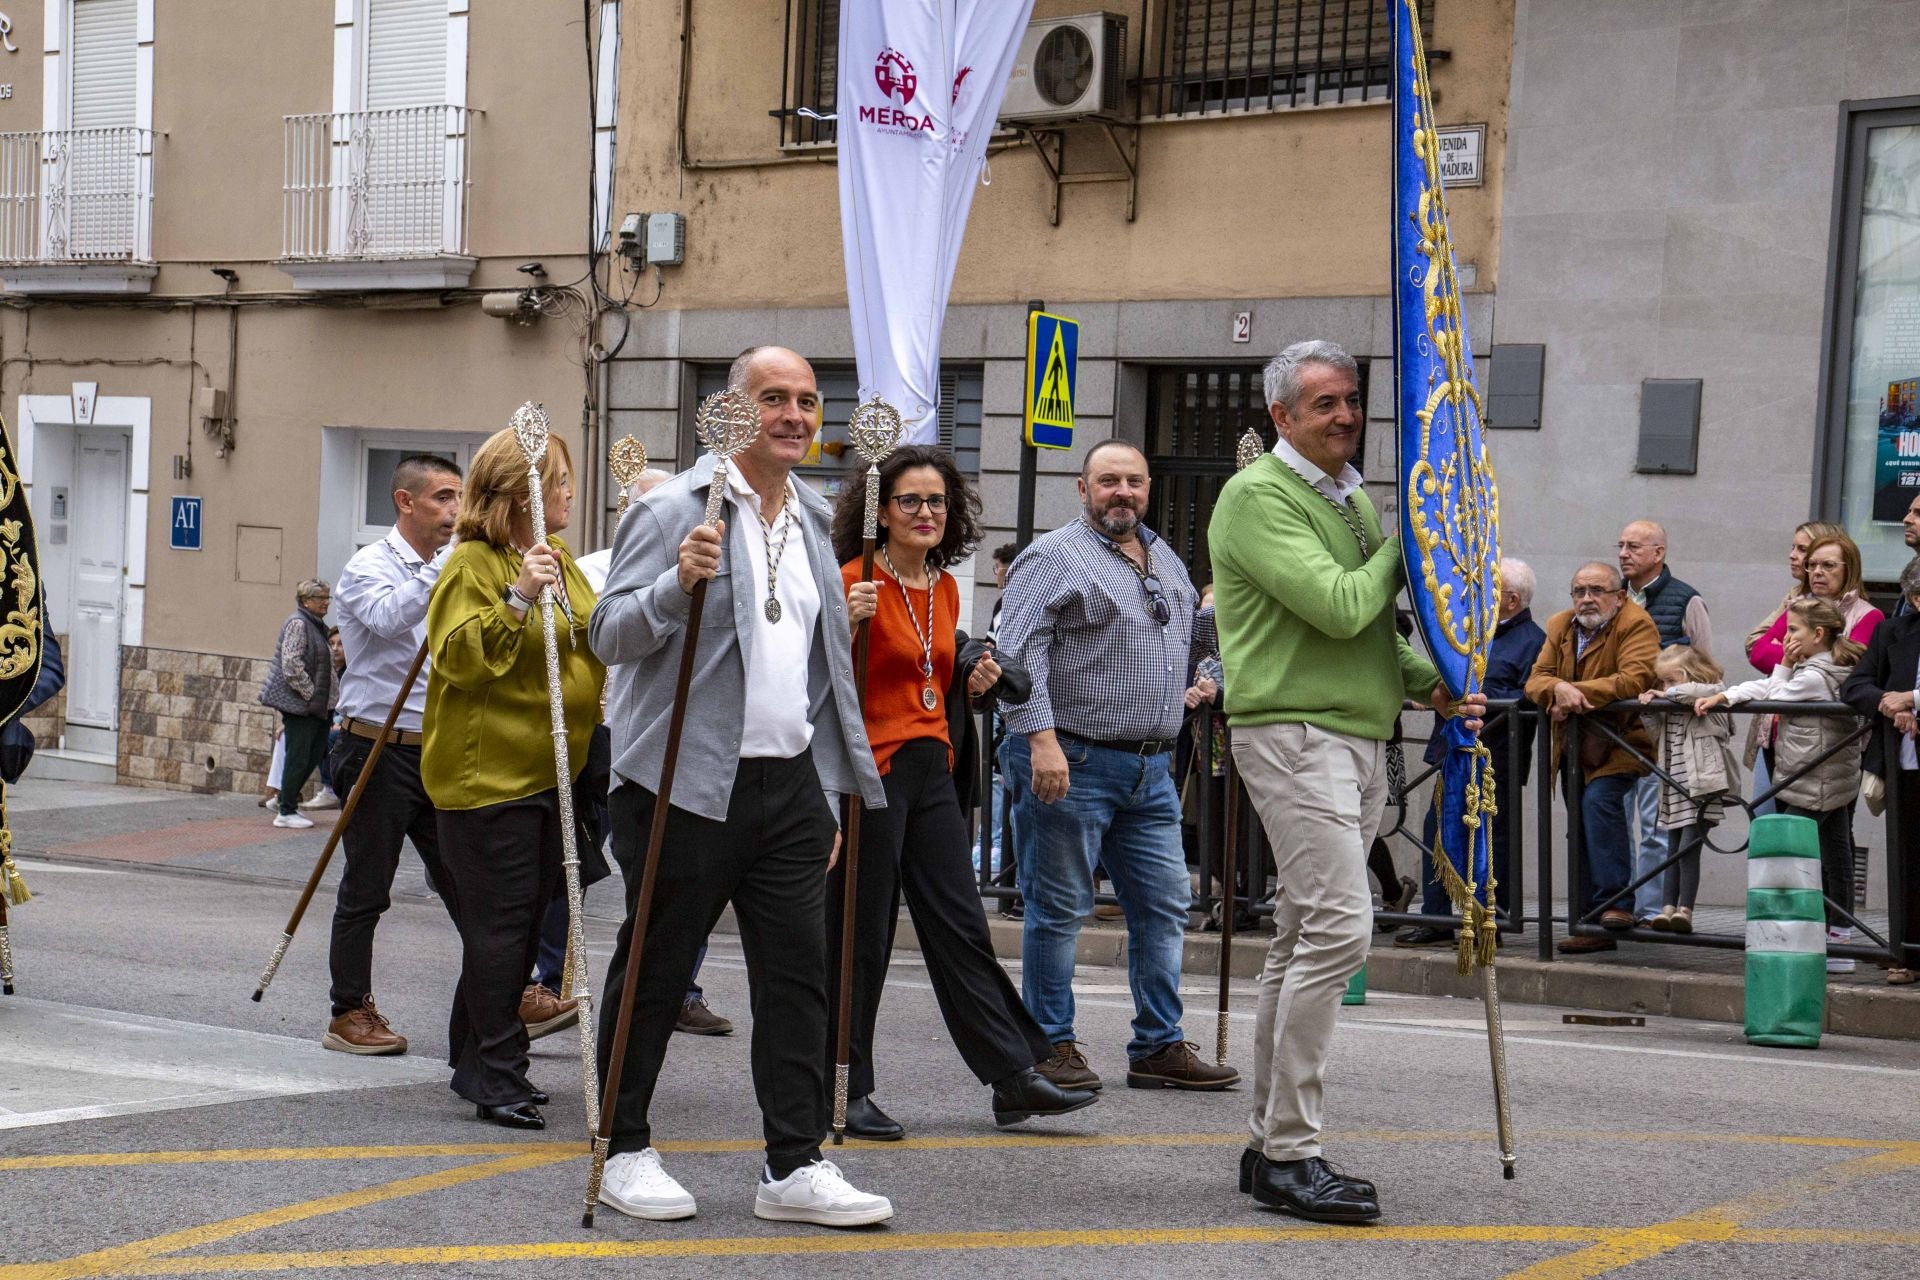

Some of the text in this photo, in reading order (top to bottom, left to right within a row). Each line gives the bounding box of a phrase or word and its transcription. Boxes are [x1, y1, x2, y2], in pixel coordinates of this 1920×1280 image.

[1438, 137, 1468, 151] VENIDA
[1446, 152, 1455, 162] DE
[1239, 316, 1248, 338] 2
[1899, 431, 1920, 457] HO
[1901, 476, 1916, 486] 12
[174, 501, 198, 529] AT
